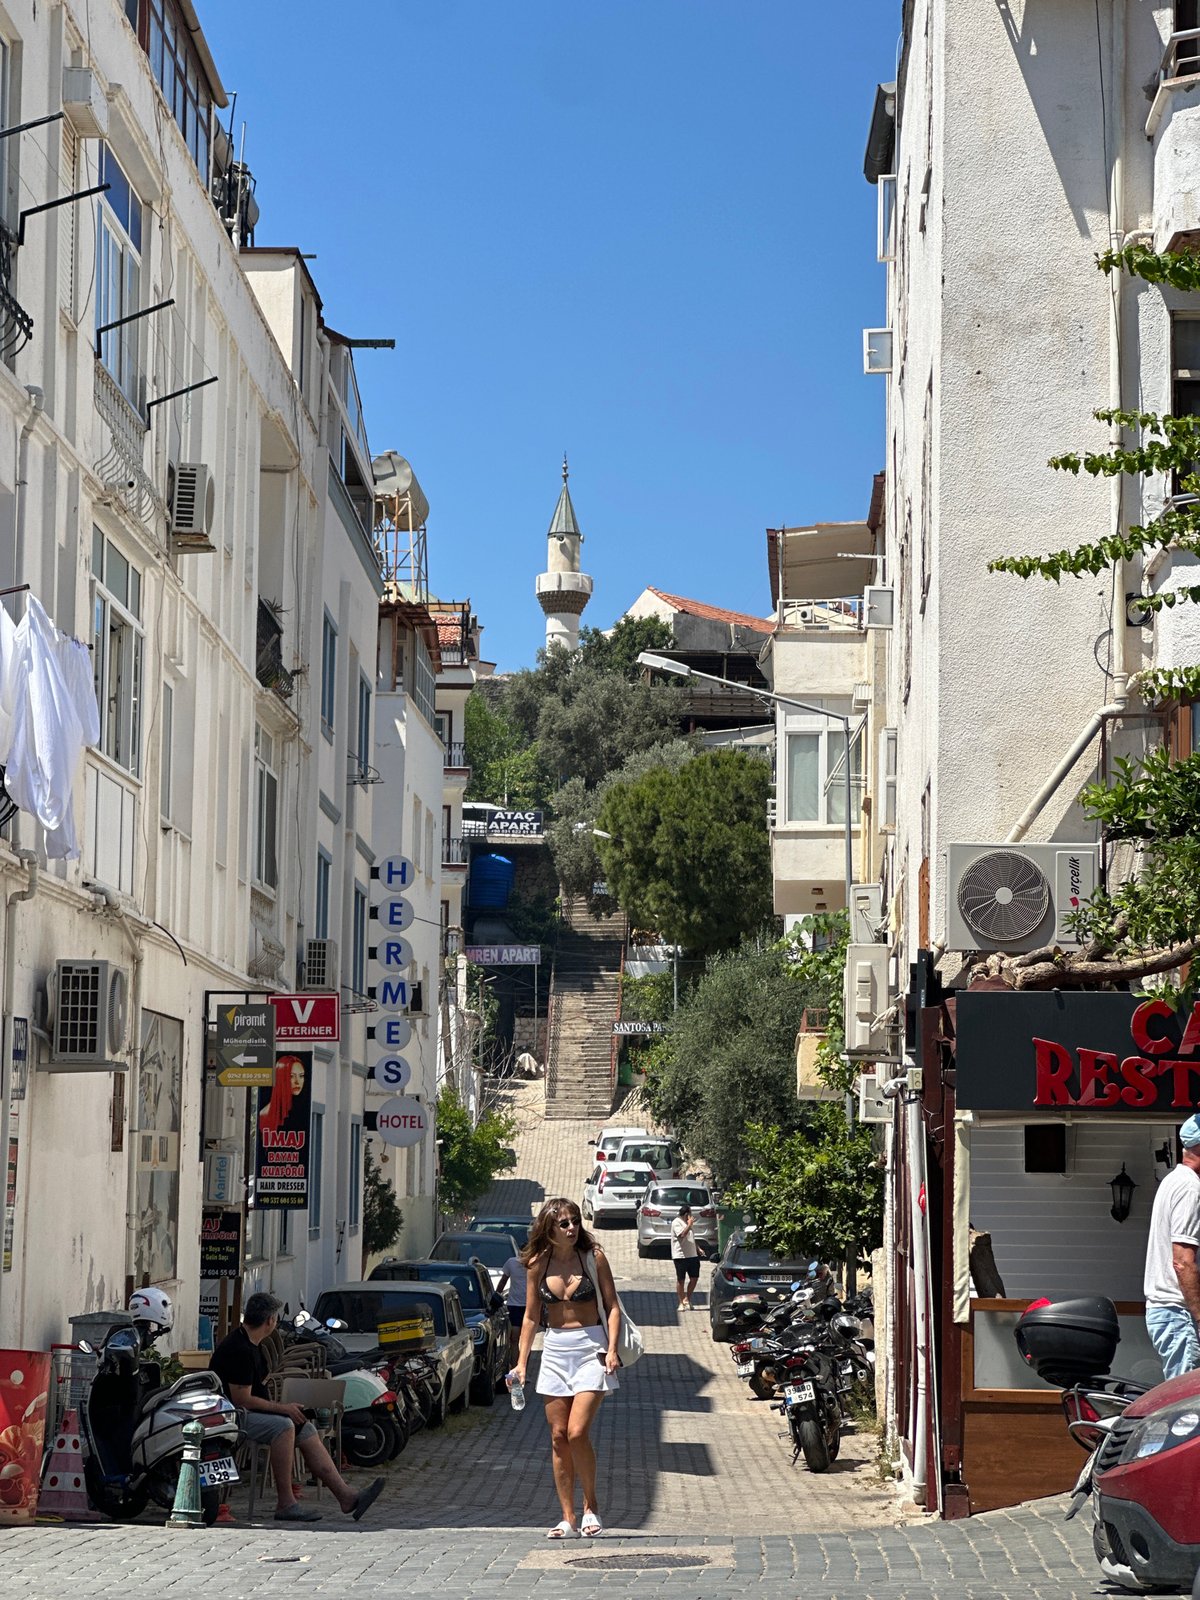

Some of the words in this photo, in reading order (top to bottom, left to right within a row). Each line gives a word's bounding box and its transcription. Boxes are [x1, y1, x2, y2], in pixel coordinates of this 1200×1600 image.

[494, 811, 535, 822] ATAÇ
[488, 822, 540, 830] APART
[1069, 856, 1082, 896] arçelik
[501, 948, 539, 962] APART
[382, 861, 407, 1084] HERMES
[290, 1000, 316, 1024] V
[233, 1013, 267, 1032] piramit
[613, 1022, 652, 1032] SANTOSA
[1031, 1036, 1200, 1108] REST
[379, 1114, 424, 1129] HOTEL
[267, 1151, 300, 1163] BAYAN
[261, 1163, 305, 1178] KUAFÖRÜ
[259, 1181, 276, 1191] HAIR
[277, 1181, 305, 1191] DRESSER
[797, 1391, 814, 1401] 574
[211, 1458, 232, 1471] BMV
[208, 1470, 230, 1484] 928
